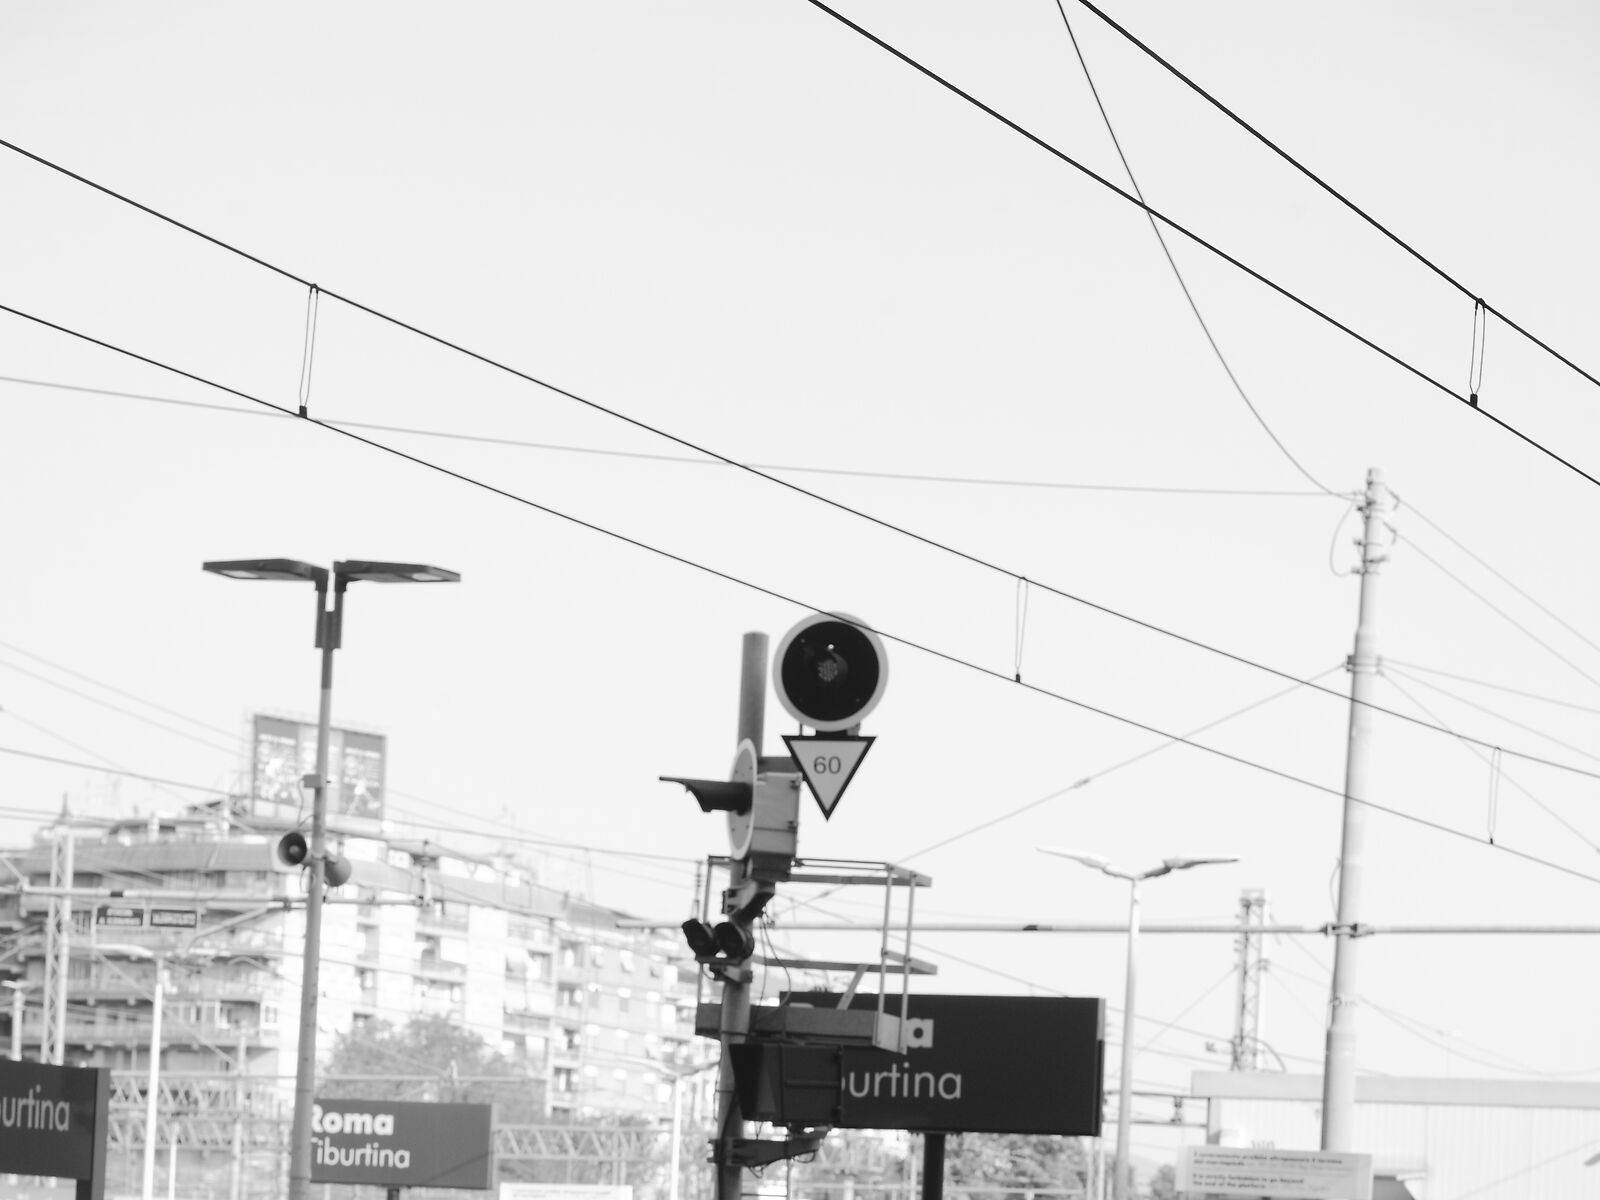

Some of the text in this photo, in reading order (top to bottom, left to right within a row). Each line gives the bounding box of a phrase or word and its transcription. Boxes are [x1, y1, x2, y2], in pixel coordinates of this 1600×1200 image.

[813, 755, 842, 775] 60
[842, 1061, 962, 1100] urtina
[0, 1084, 70, 1132] urtina
